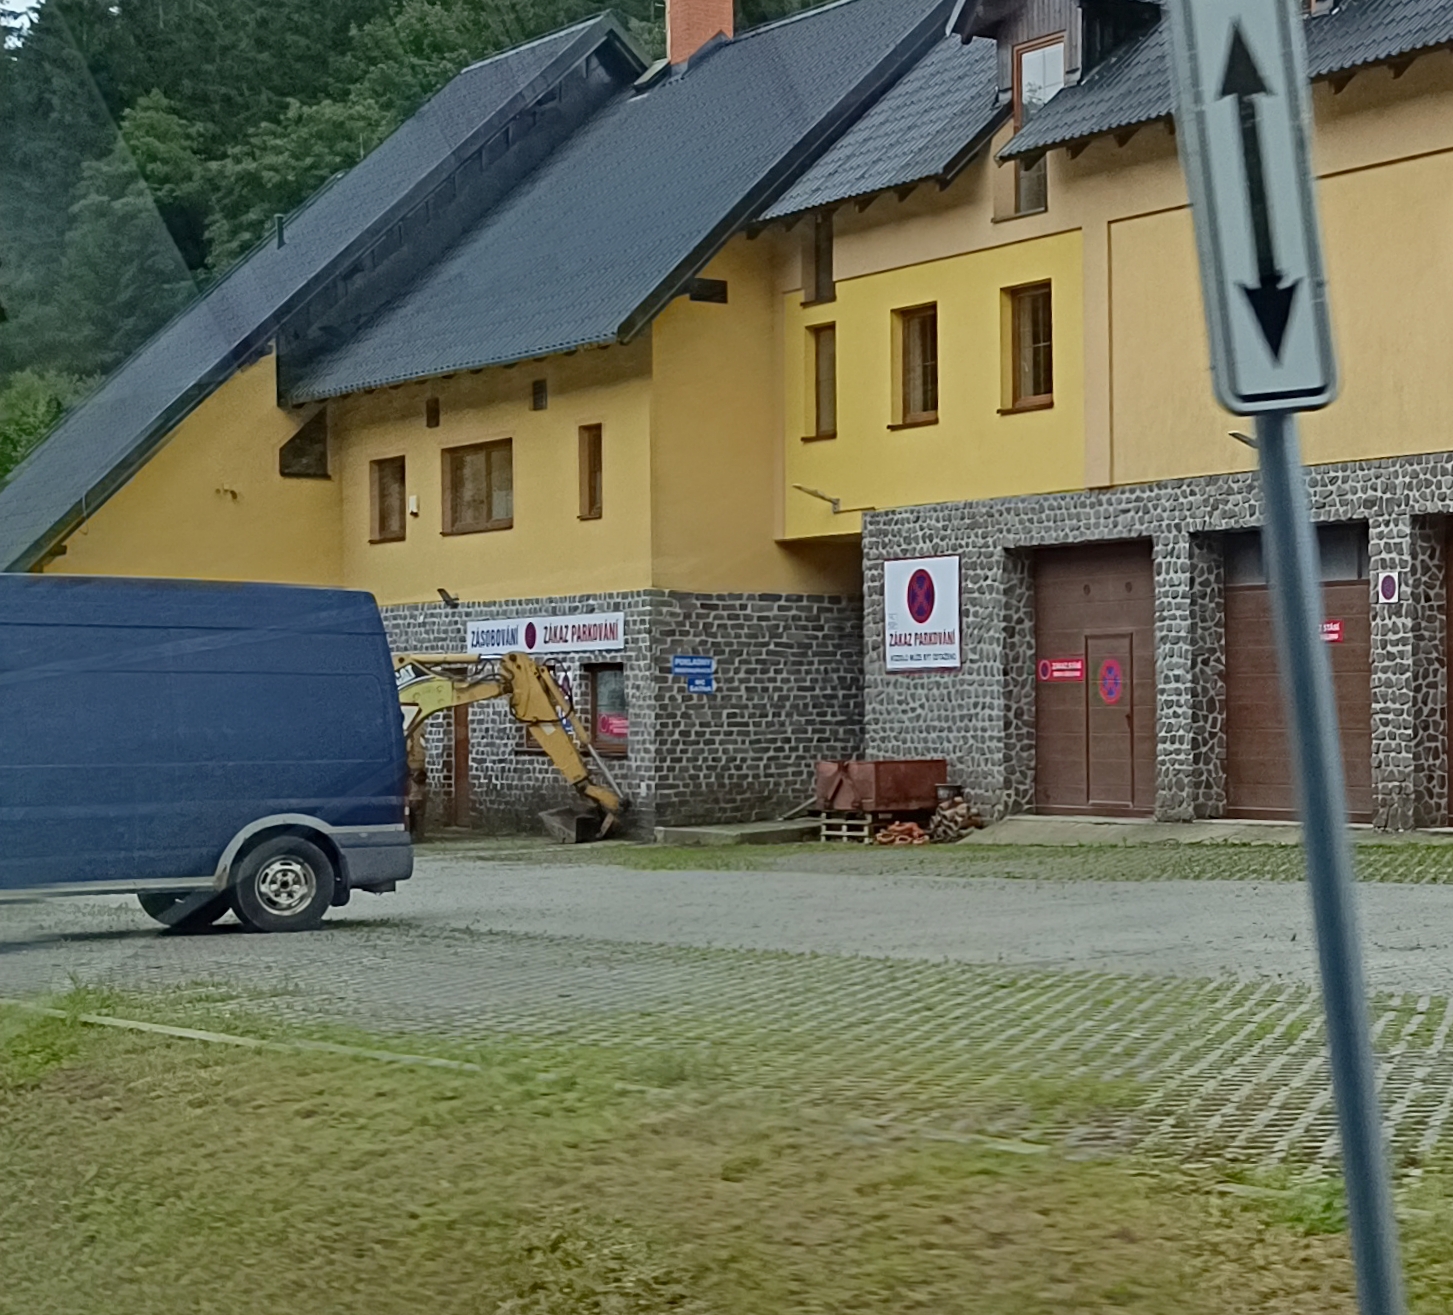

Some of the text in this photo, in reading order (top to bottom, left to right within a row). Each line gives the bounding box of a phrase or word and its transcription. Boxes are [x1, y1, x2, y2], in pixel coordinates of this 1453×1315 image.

[471, 625, 519, 648] ZÁSOBOVÁNÍ
[543, 618, 619, 644] ZÁKAZ PARKOVÁNÍ
[889, 628, 956, 647] ZÁKAZ PARKOVÁNÍ
